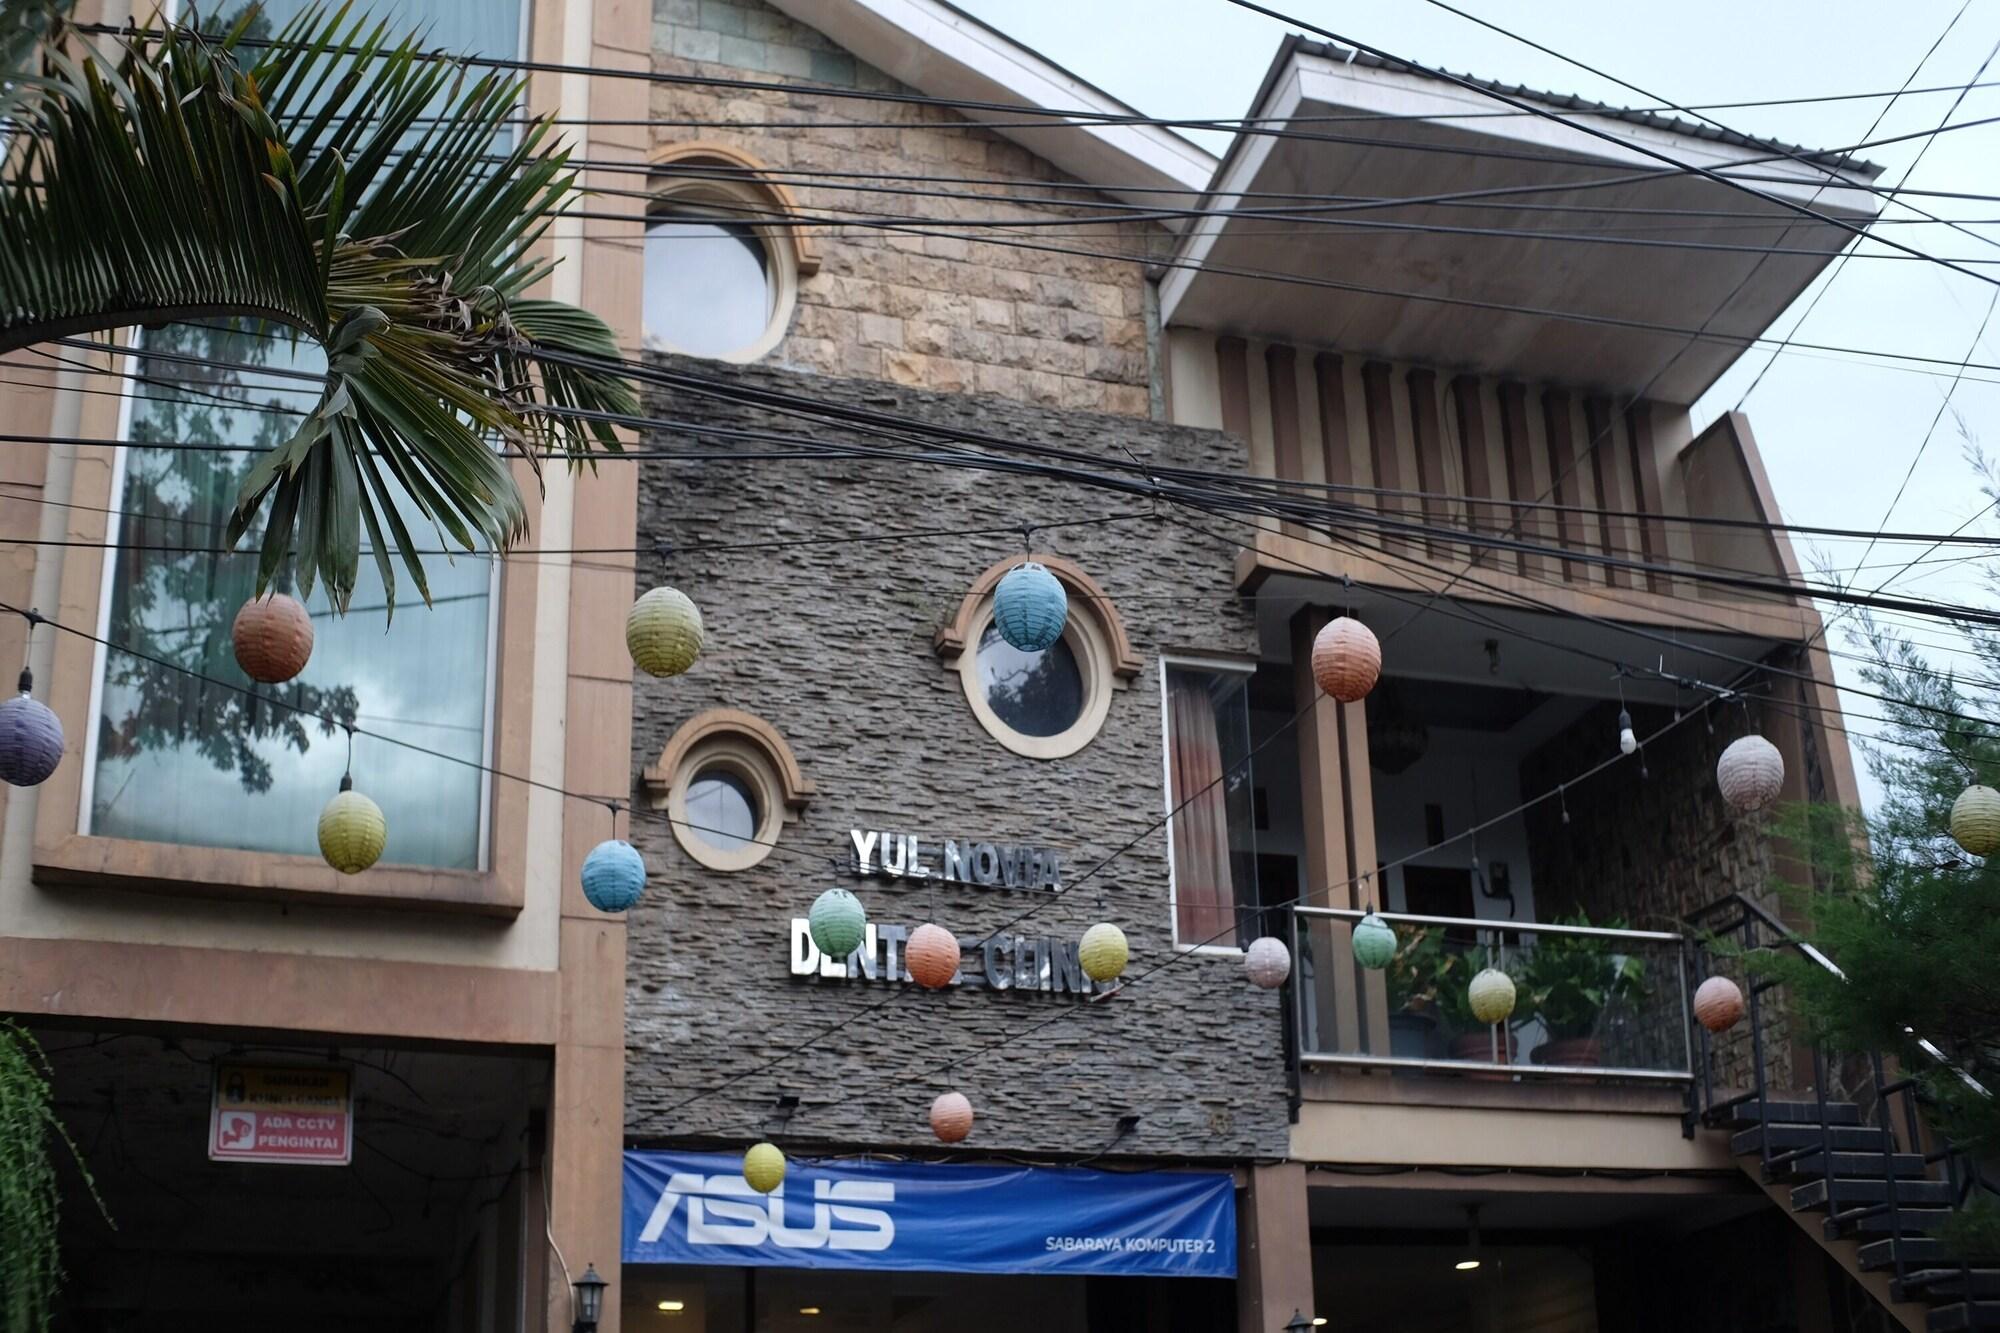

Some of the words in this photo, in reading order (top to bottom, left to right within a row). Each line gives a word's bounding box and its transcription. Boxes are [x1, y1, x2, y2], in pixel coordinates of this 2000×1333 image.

[262, 1117, 292, 1129] ADA
[296, 1118, 336, 1130] CCTV
[258, 1135, 338, 1149] PENGINTAI
[638, 1173, 895, 1251] ASUS
[1046, 1236, 1122, 1252] SABARAYA
[1125, 1238, 1204, 1253] KOMPUTER
[1206, 1239, 1216, 1253] 2
